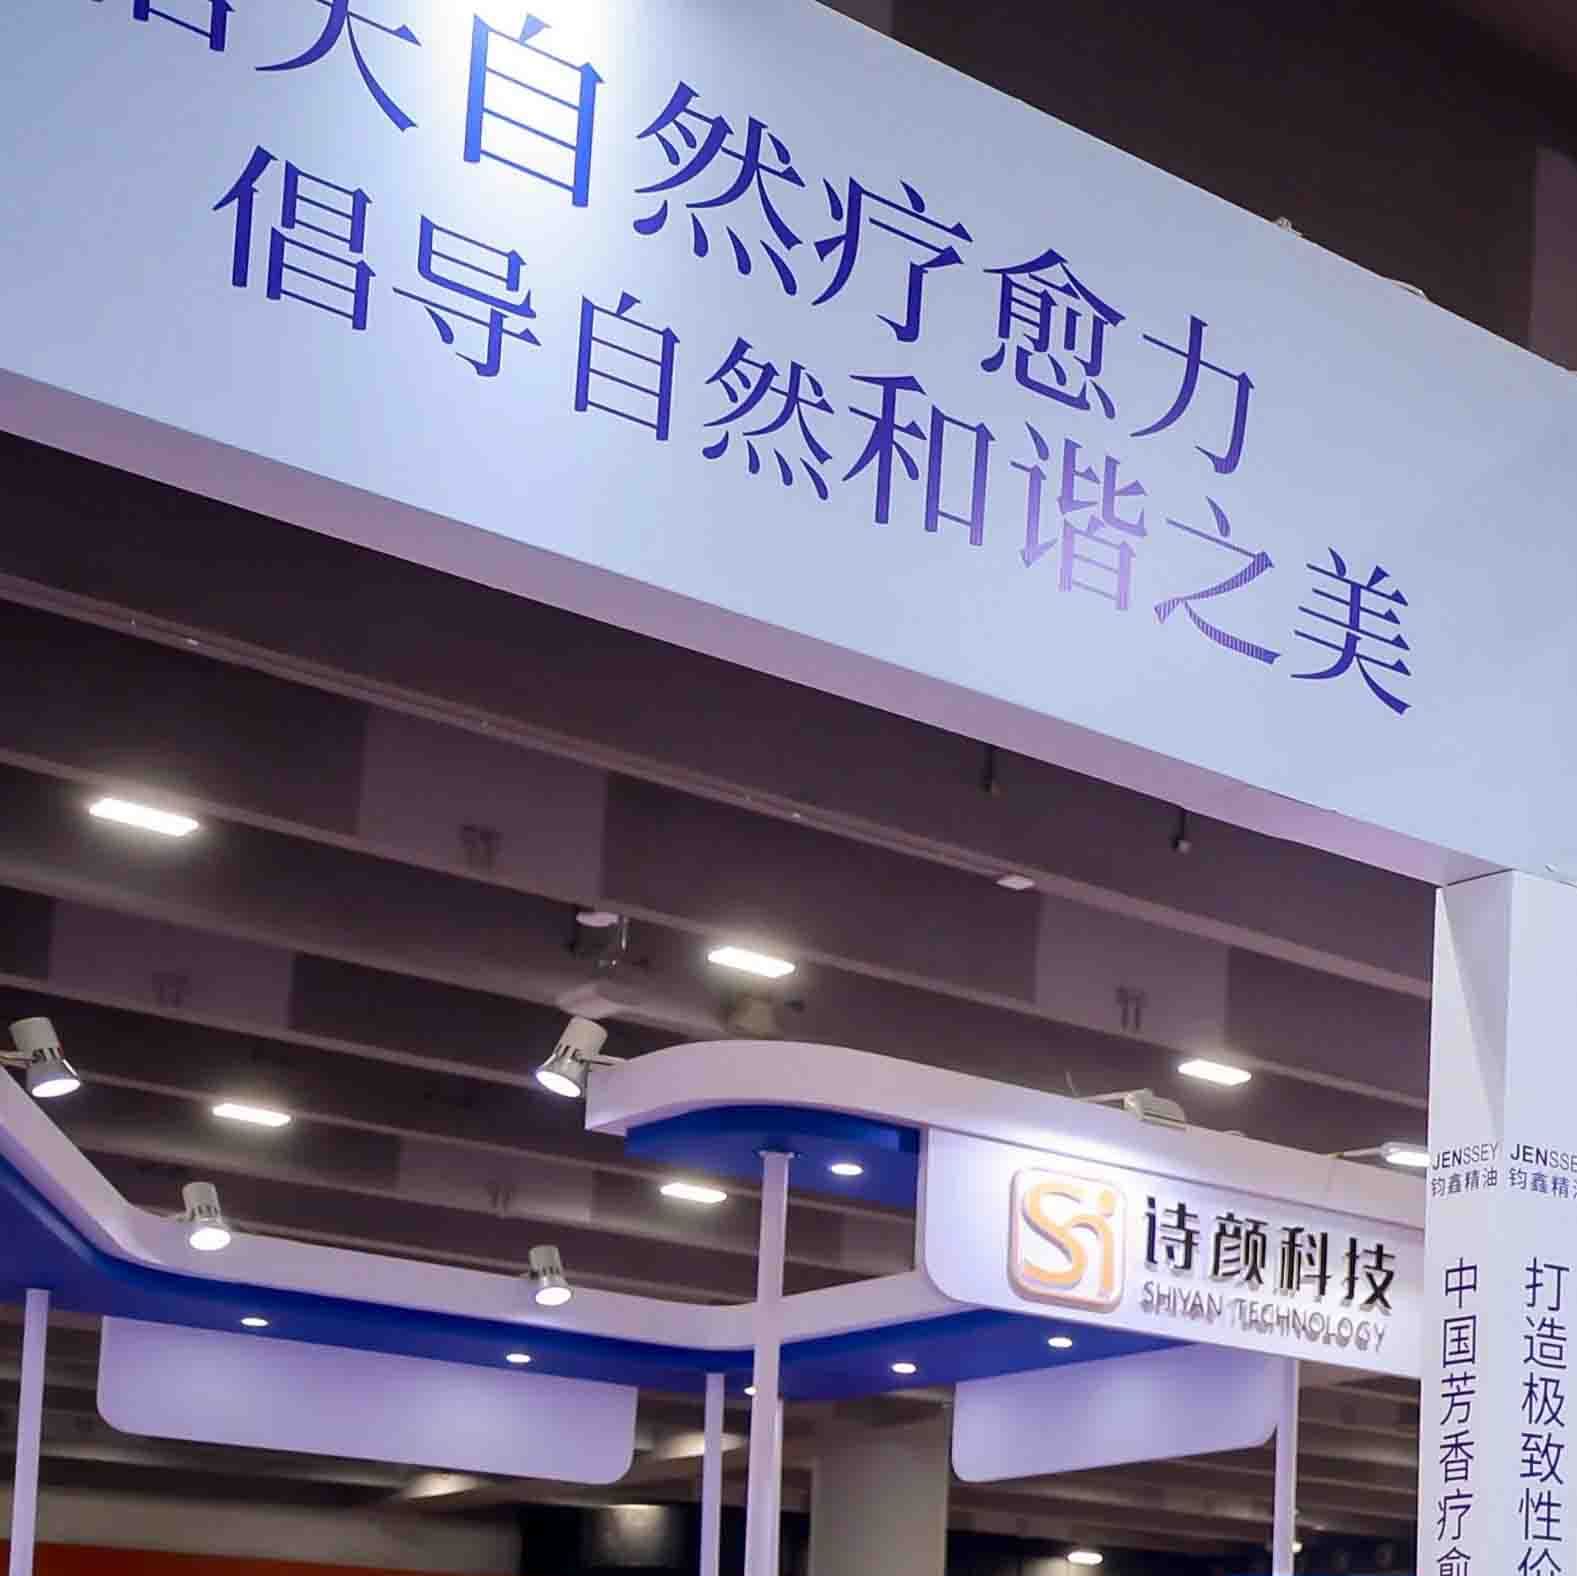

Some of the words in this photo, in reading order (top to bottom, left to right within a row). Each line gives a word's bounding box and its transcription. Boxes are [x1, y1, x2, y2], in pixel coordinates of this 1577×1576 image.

[130, 0, 1255, 476] 大自然疗愈力
[212, 144, 1412, 715] 倡导自然和谐之美
[1432, 1142, 1499, 1171] JENSSEY
[1142, 1196, 1397, 1311] 诗颜科技
[1141, 1280, 1224, 1325] SHIYAN
[1231, 1297, 1387, 1351] TECHNOLOGY
